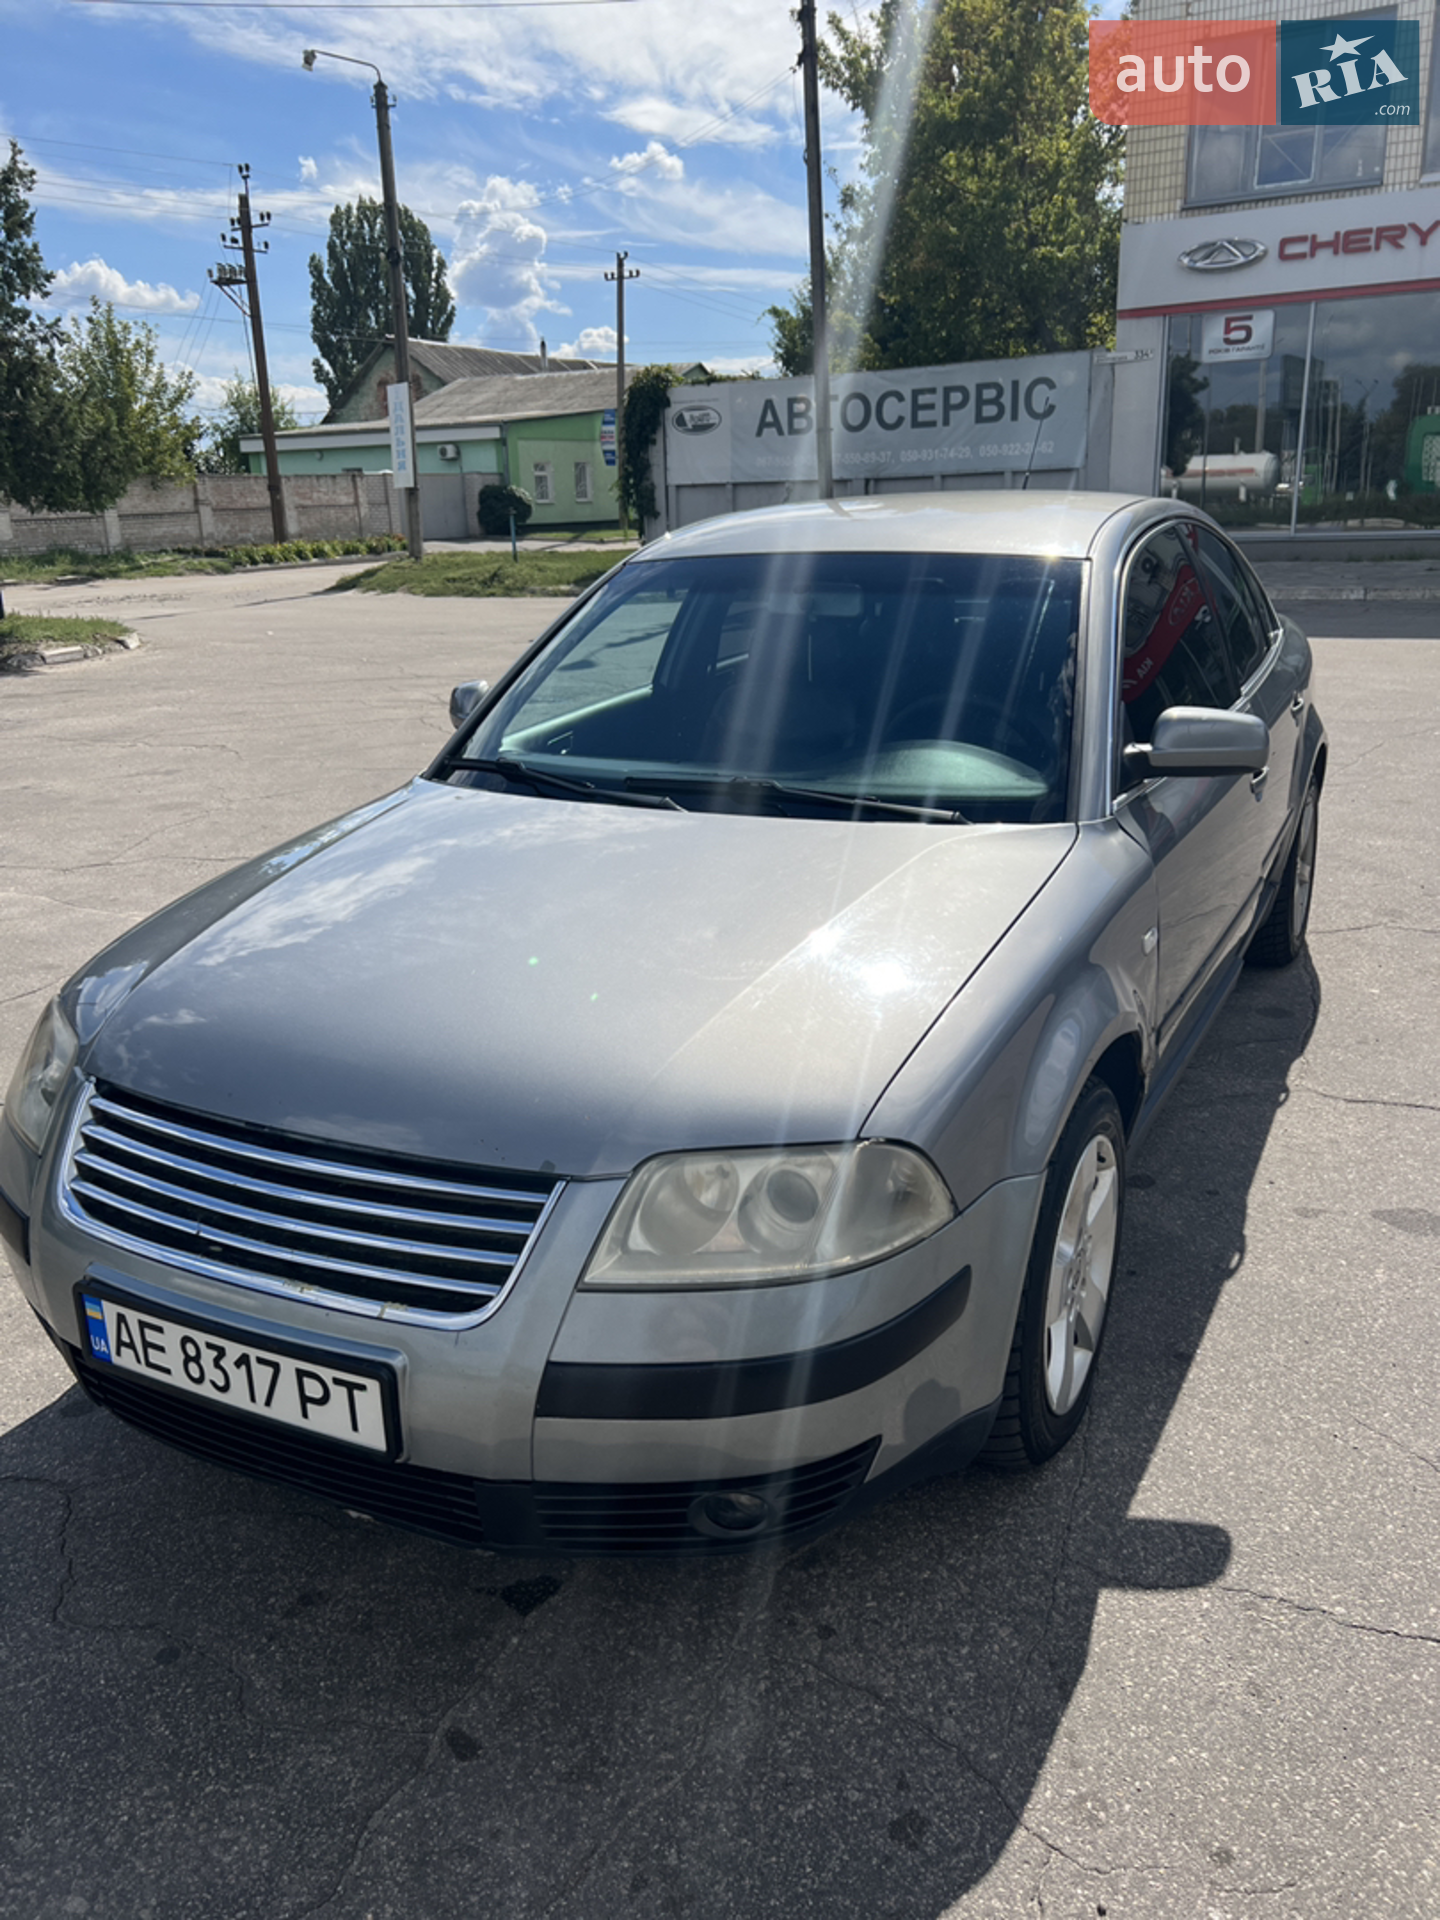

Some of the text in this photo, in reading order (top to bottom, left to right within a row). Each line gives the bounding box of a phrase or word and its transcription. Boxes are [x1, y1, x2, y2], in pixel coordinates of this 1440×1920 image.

[1277, 219, 1440, 262] CHERY
[1222, 314, 1254, 346] 5
[755, 375, 1058, 438] АВОСЕРВІС
[90, 1336, 109, 1355] UA
[114, 1311, 368, 1433] AE 8317 PT
